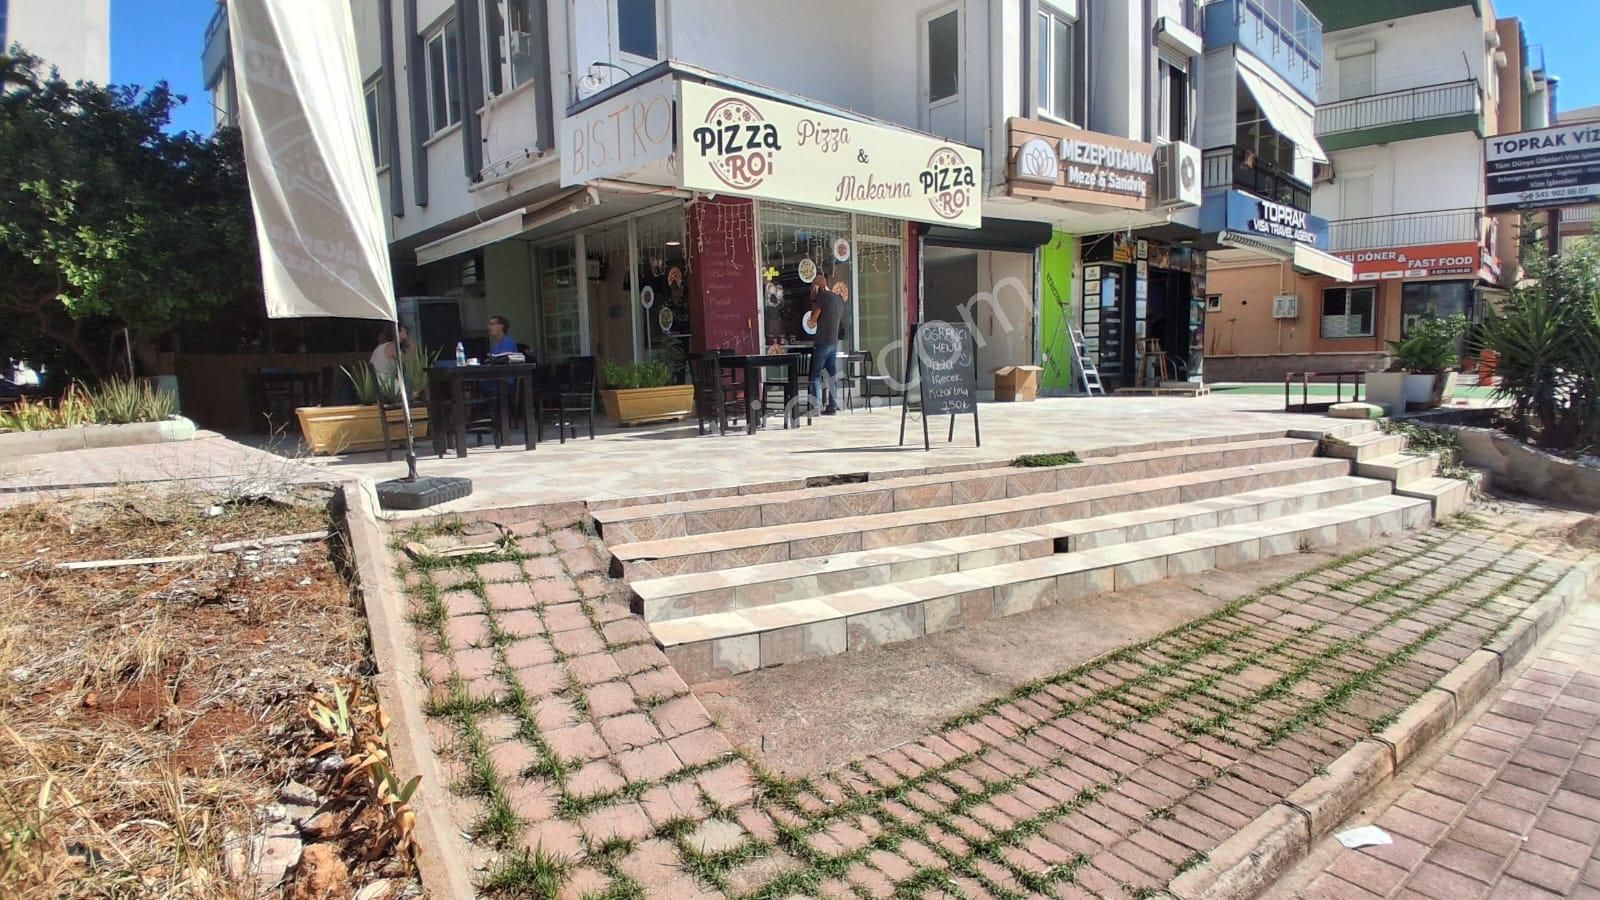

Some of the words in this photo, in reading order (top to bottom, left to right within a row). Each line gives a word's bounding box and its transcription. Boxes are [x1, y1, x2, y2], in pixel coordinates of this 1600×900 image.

[573, 94, 671, 176] BISTRO
[797, 119, 850, 153] Pizza
[1493, 133, 1566, 155] TOPRAK
[857, 148, 869, 164] &
[1060, 138, 1154, 174] MEZEPOTAMYA
[835, 174, 912, 202] Makarna
[1067, 165, 1096, 186] Meze
[1097, 170, 1106, 187] &
[1106, 172, 1146, 197] Sandviç
[1262, 200, 1306, 230] TOPRAK
[1254, 218, 1270, 233] VISA
[1270, 223, 1294, 239] TRAVEL
[1294, 229, 1317, 243] AGENCY
[1357, 251, 1396, 262] DÖNER
[1397, 253, 1407, 263] &
[1408, 258, 1436, 268] FAST
[1439, 256, 1473, 267] FOOD
